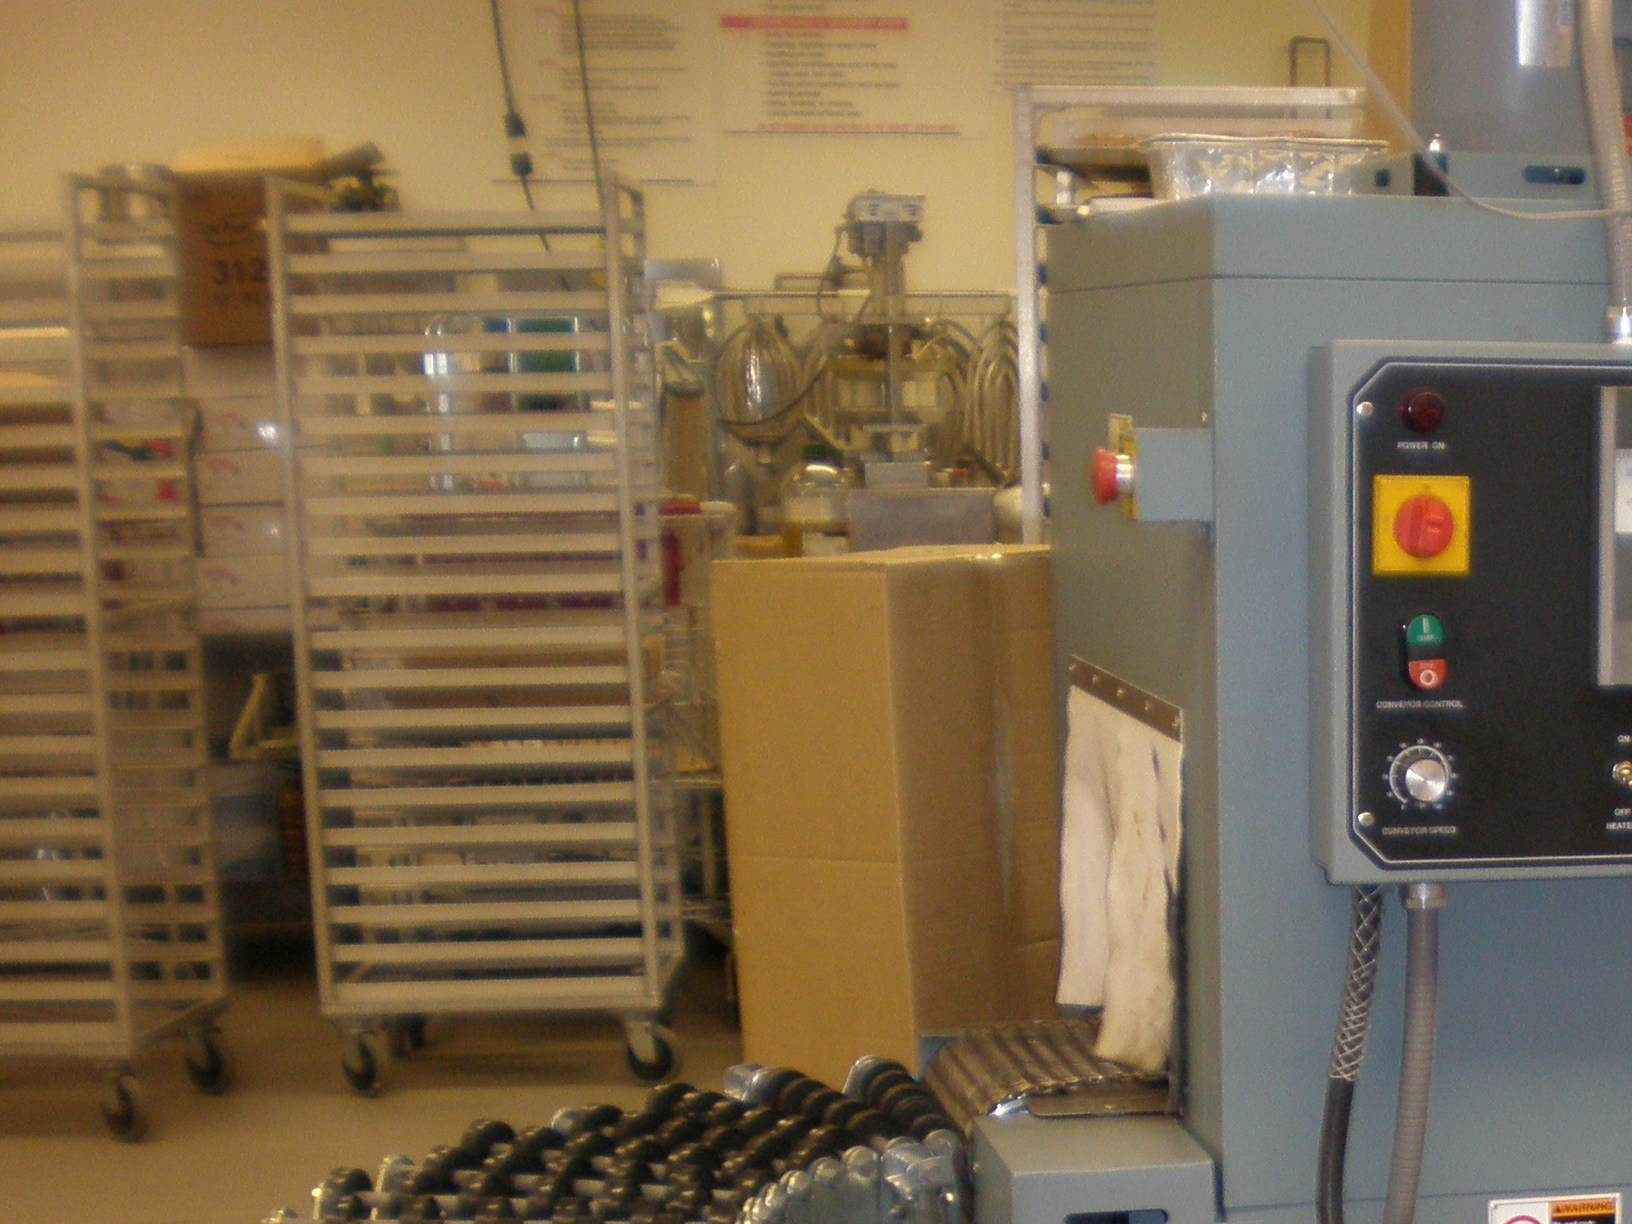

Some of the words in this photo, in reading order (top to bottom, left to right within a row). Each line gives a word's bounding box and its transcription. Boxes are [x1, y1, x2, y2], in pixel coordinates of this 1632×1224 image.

[1397, 441, 1429, 450] POWER
[1432, 441, 1447, 450] ON
[1376, 700, 1421, 709] CONVEYOR
[1423, 700, 1464, 708] CONTROL
[1563, 1202, 1613, 1212] WARNING
